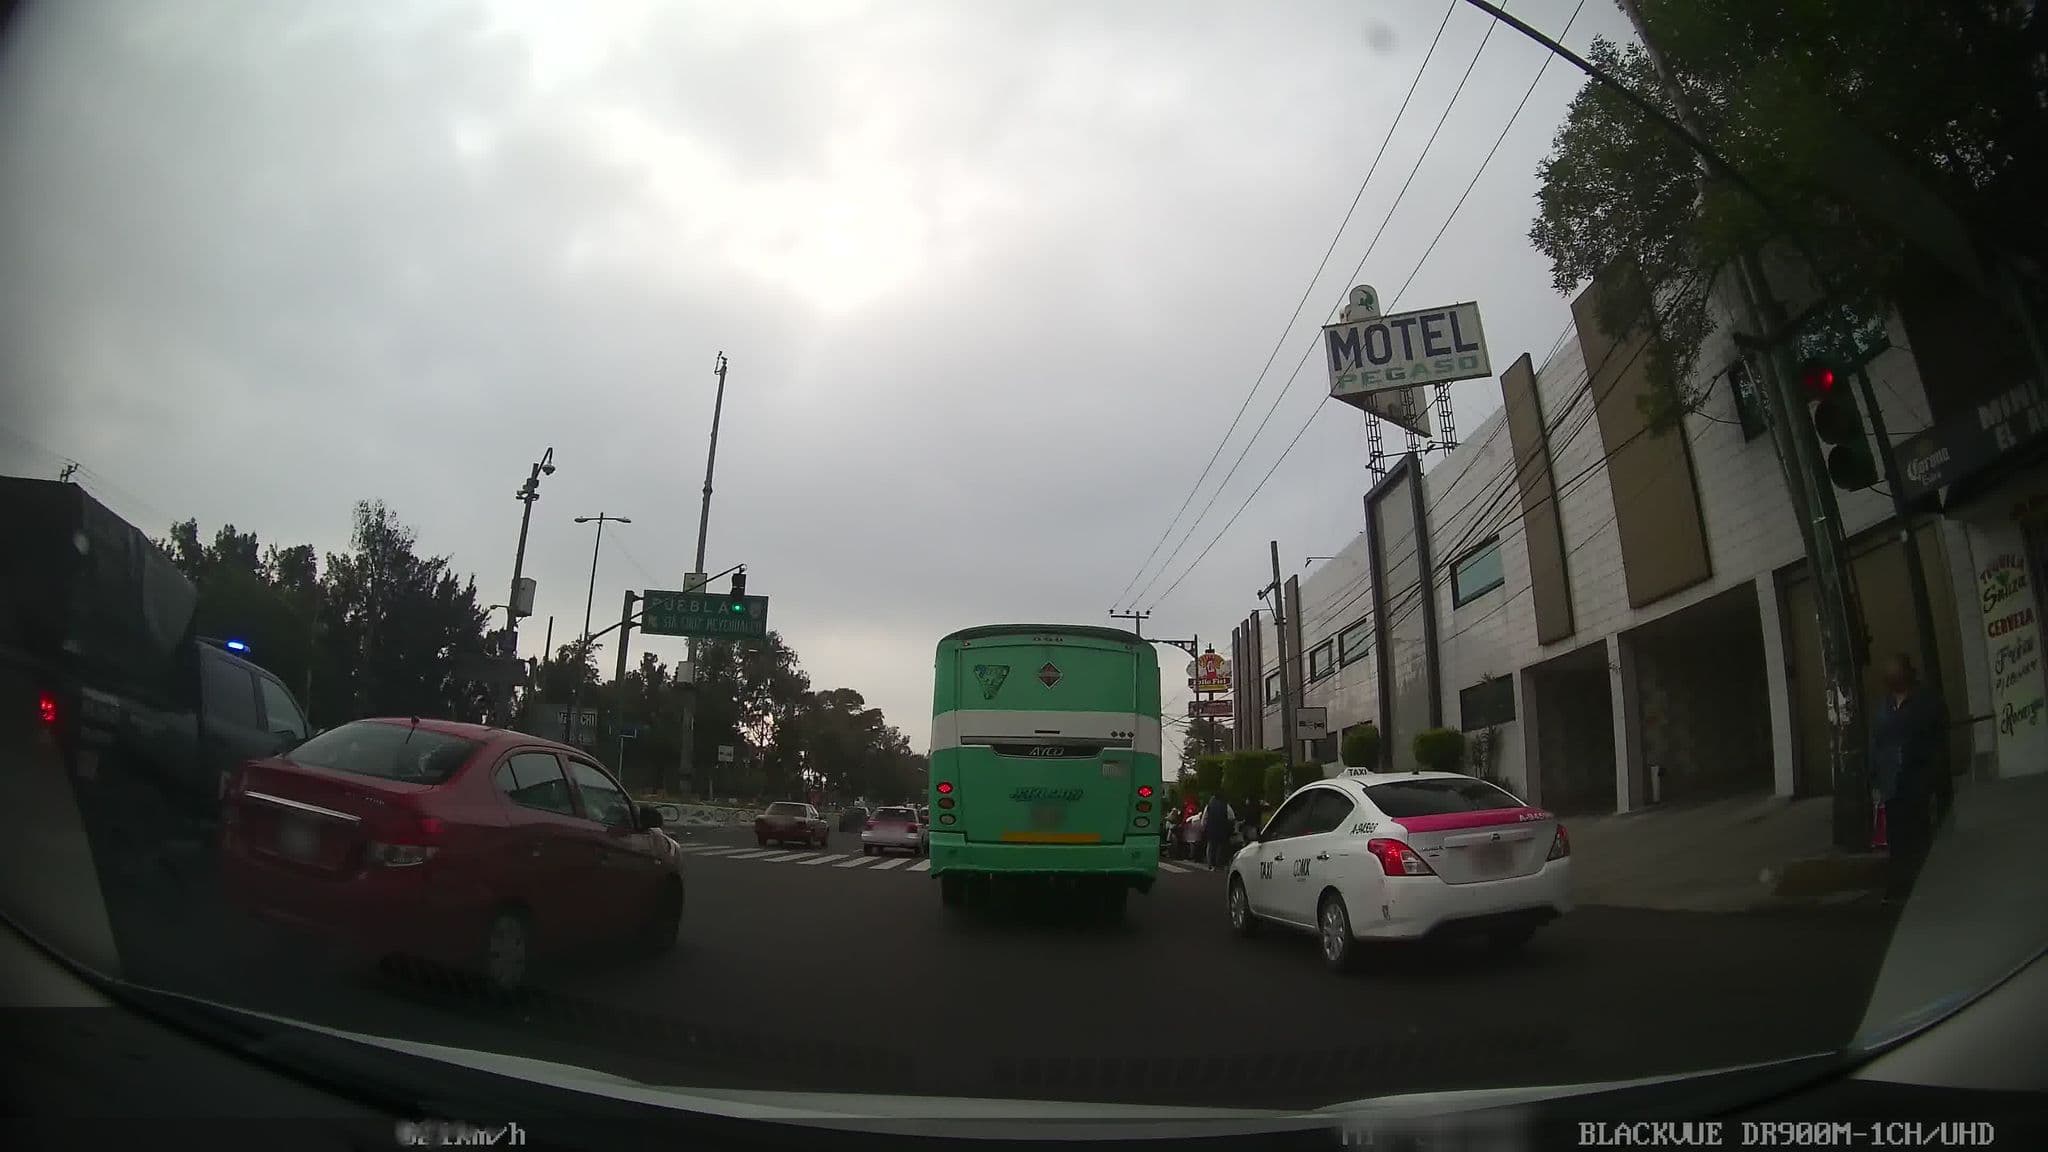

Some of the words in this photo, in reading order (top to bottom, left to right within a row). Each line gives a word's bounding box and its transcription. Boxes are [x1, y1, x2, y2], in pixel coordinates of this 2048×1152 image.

[1329, 310, 1479, 372] MOTEL
[1335, 354, 1481, 391] PEGASO
[1987, 606, 2036, 638] CERVEZA
[1347, 768, 1368, 777] TAXI
[1259, 861, 1274, 880] TAXI
